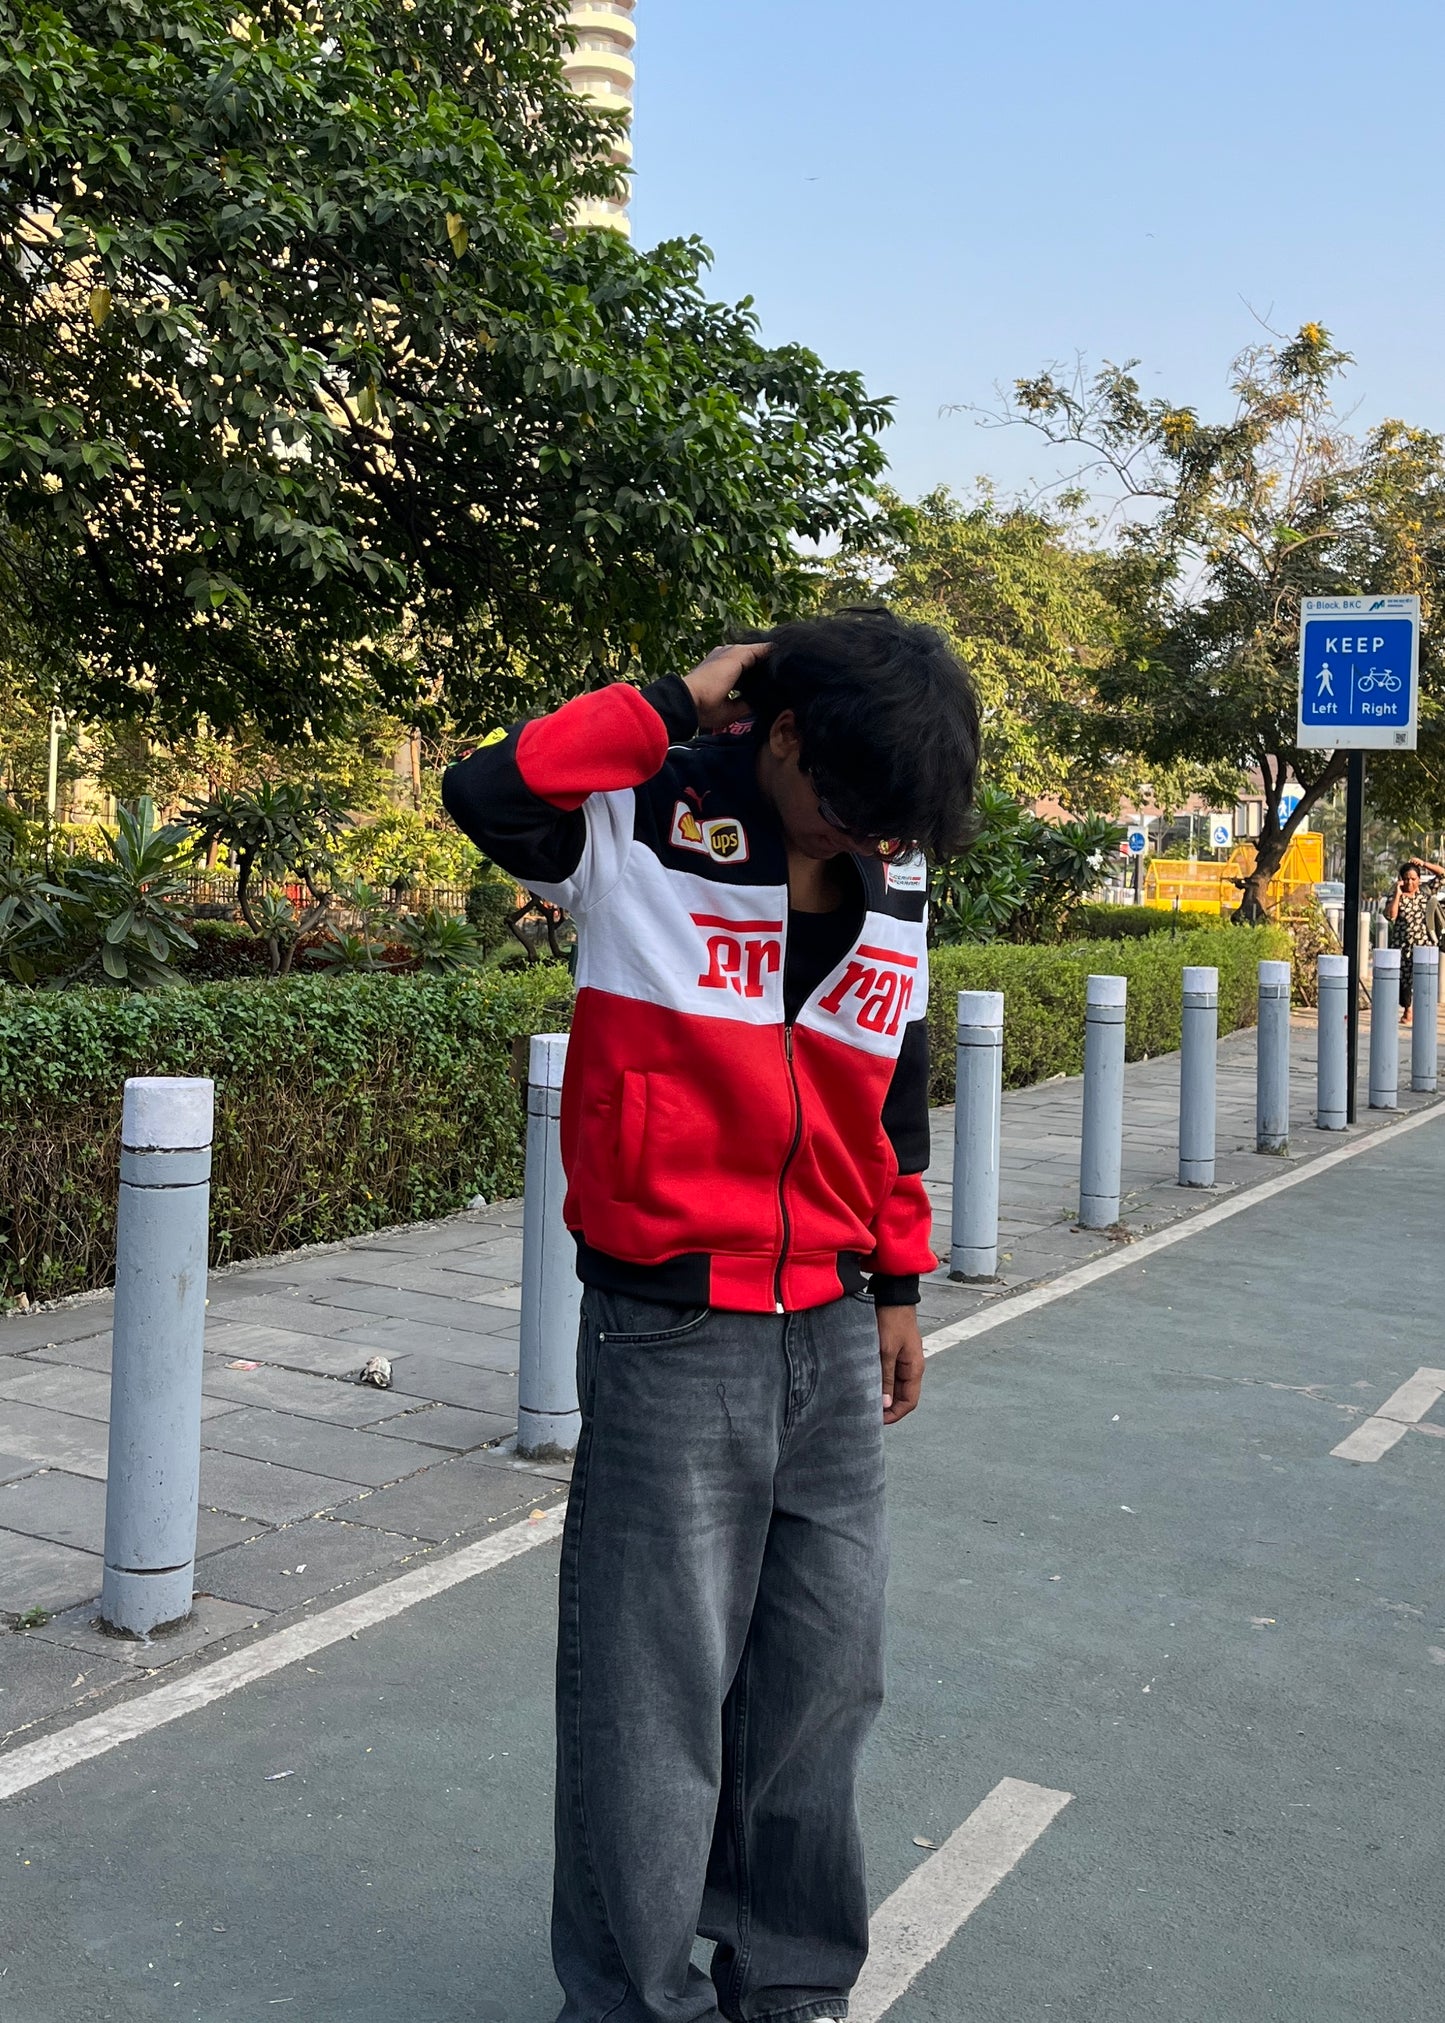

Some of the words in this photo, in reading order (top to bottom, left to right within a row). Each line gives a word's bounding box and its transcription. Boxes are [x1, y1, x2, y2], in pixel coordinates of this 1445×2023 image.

[1343, 600, 1362, 609] BKC
[1326, 637, 1385, 653] KEEP
[1312, 702, 1338, 714] Left
[1362, 702, 1398, 717] Right
[712, 832, 738, 854] ups
